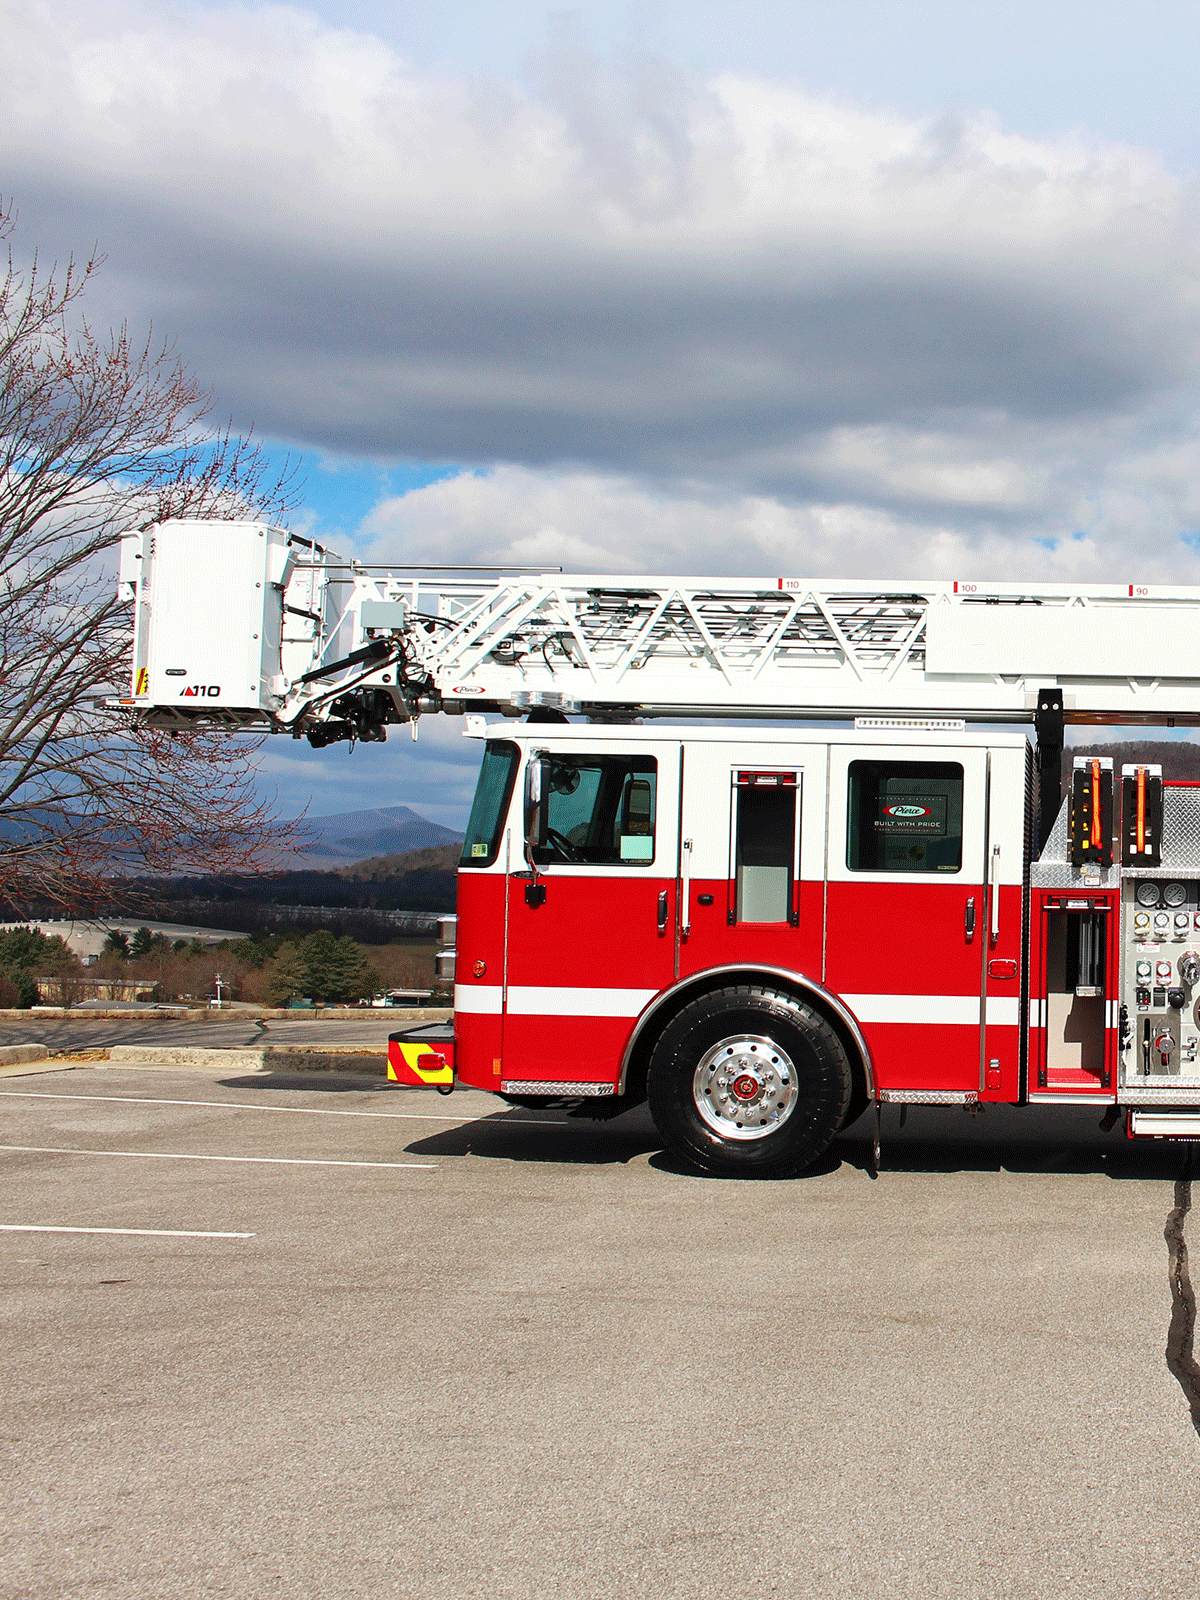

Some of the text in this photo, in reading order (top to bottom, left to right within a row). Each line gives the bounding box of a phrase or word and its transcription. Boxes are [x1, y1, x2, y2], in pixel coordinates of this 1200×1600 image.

[786, 581, 799, 589] 110
[961, 584, 977, 592] 100
[1136, 588, 1148, 596] 90
[893, 806, 920, 815] Pierce
